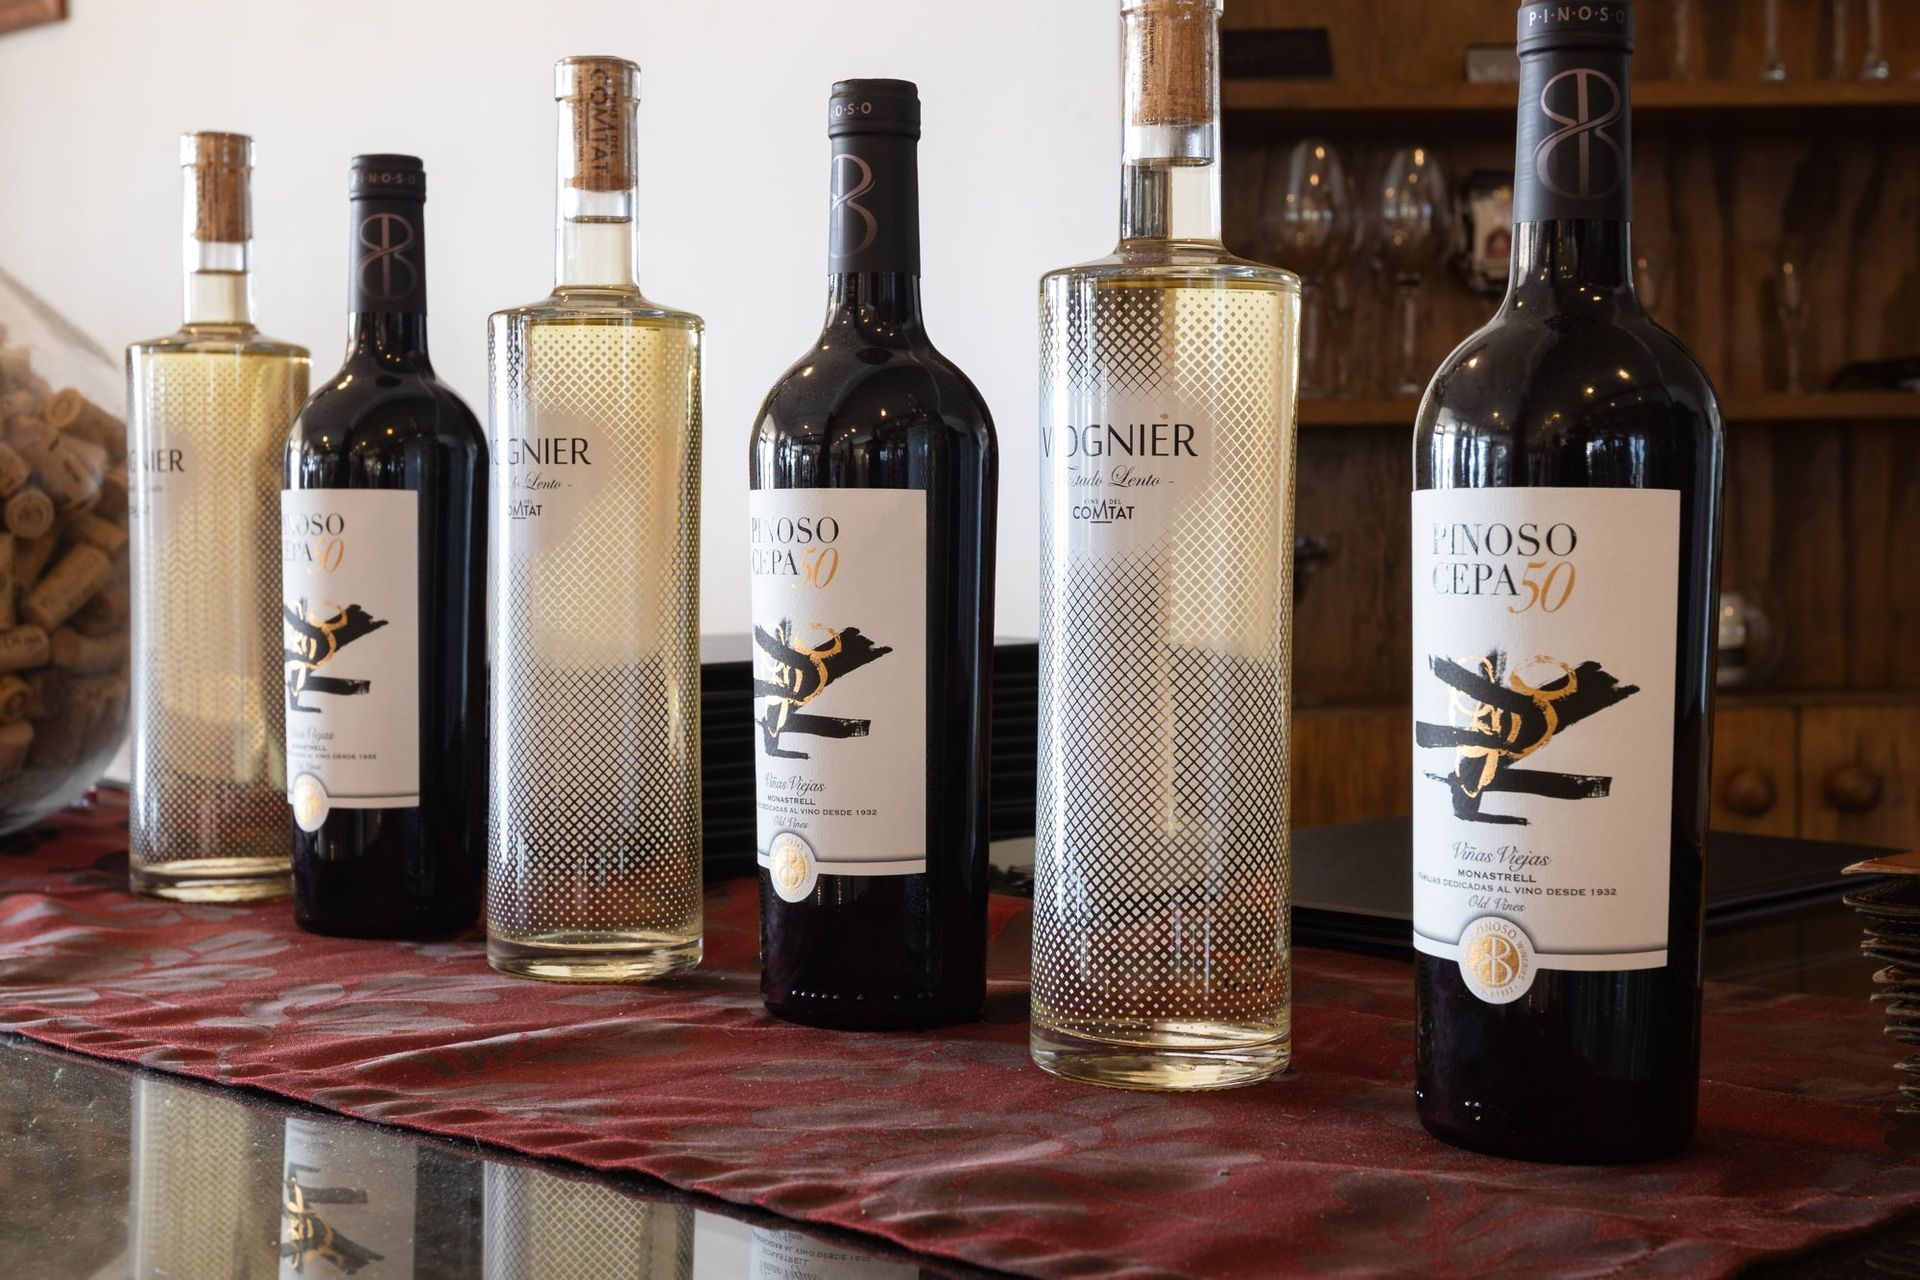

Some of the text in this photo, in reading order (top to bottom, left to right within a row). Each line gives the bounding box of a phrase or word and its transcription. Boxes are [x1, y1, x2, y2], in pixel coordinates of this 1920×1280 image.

[1109, 464, 1161, 489] Lento
[1072, 500, 1135, 520] COMTAT
[1432, 522, 1578, 557] PINOSO
[1432, 560, 1577, 614] CEPA 50
[788, 774, 827, 797] Viejas
[1452, 840, 1553, 872] Viñas Viejas
[1457, 869, 1537, 883] MONASTRELL
[1442, 880, 1494, 894] DEDICADAS
[1497, 886, 1511, 894] AL
[1515, 887, 1543, 896] VINO
[1546, 888, 1587, 897] DESDE
[1591, 888, 1618, 897] 1932
[1493, 896, 1526, 913] Vines
